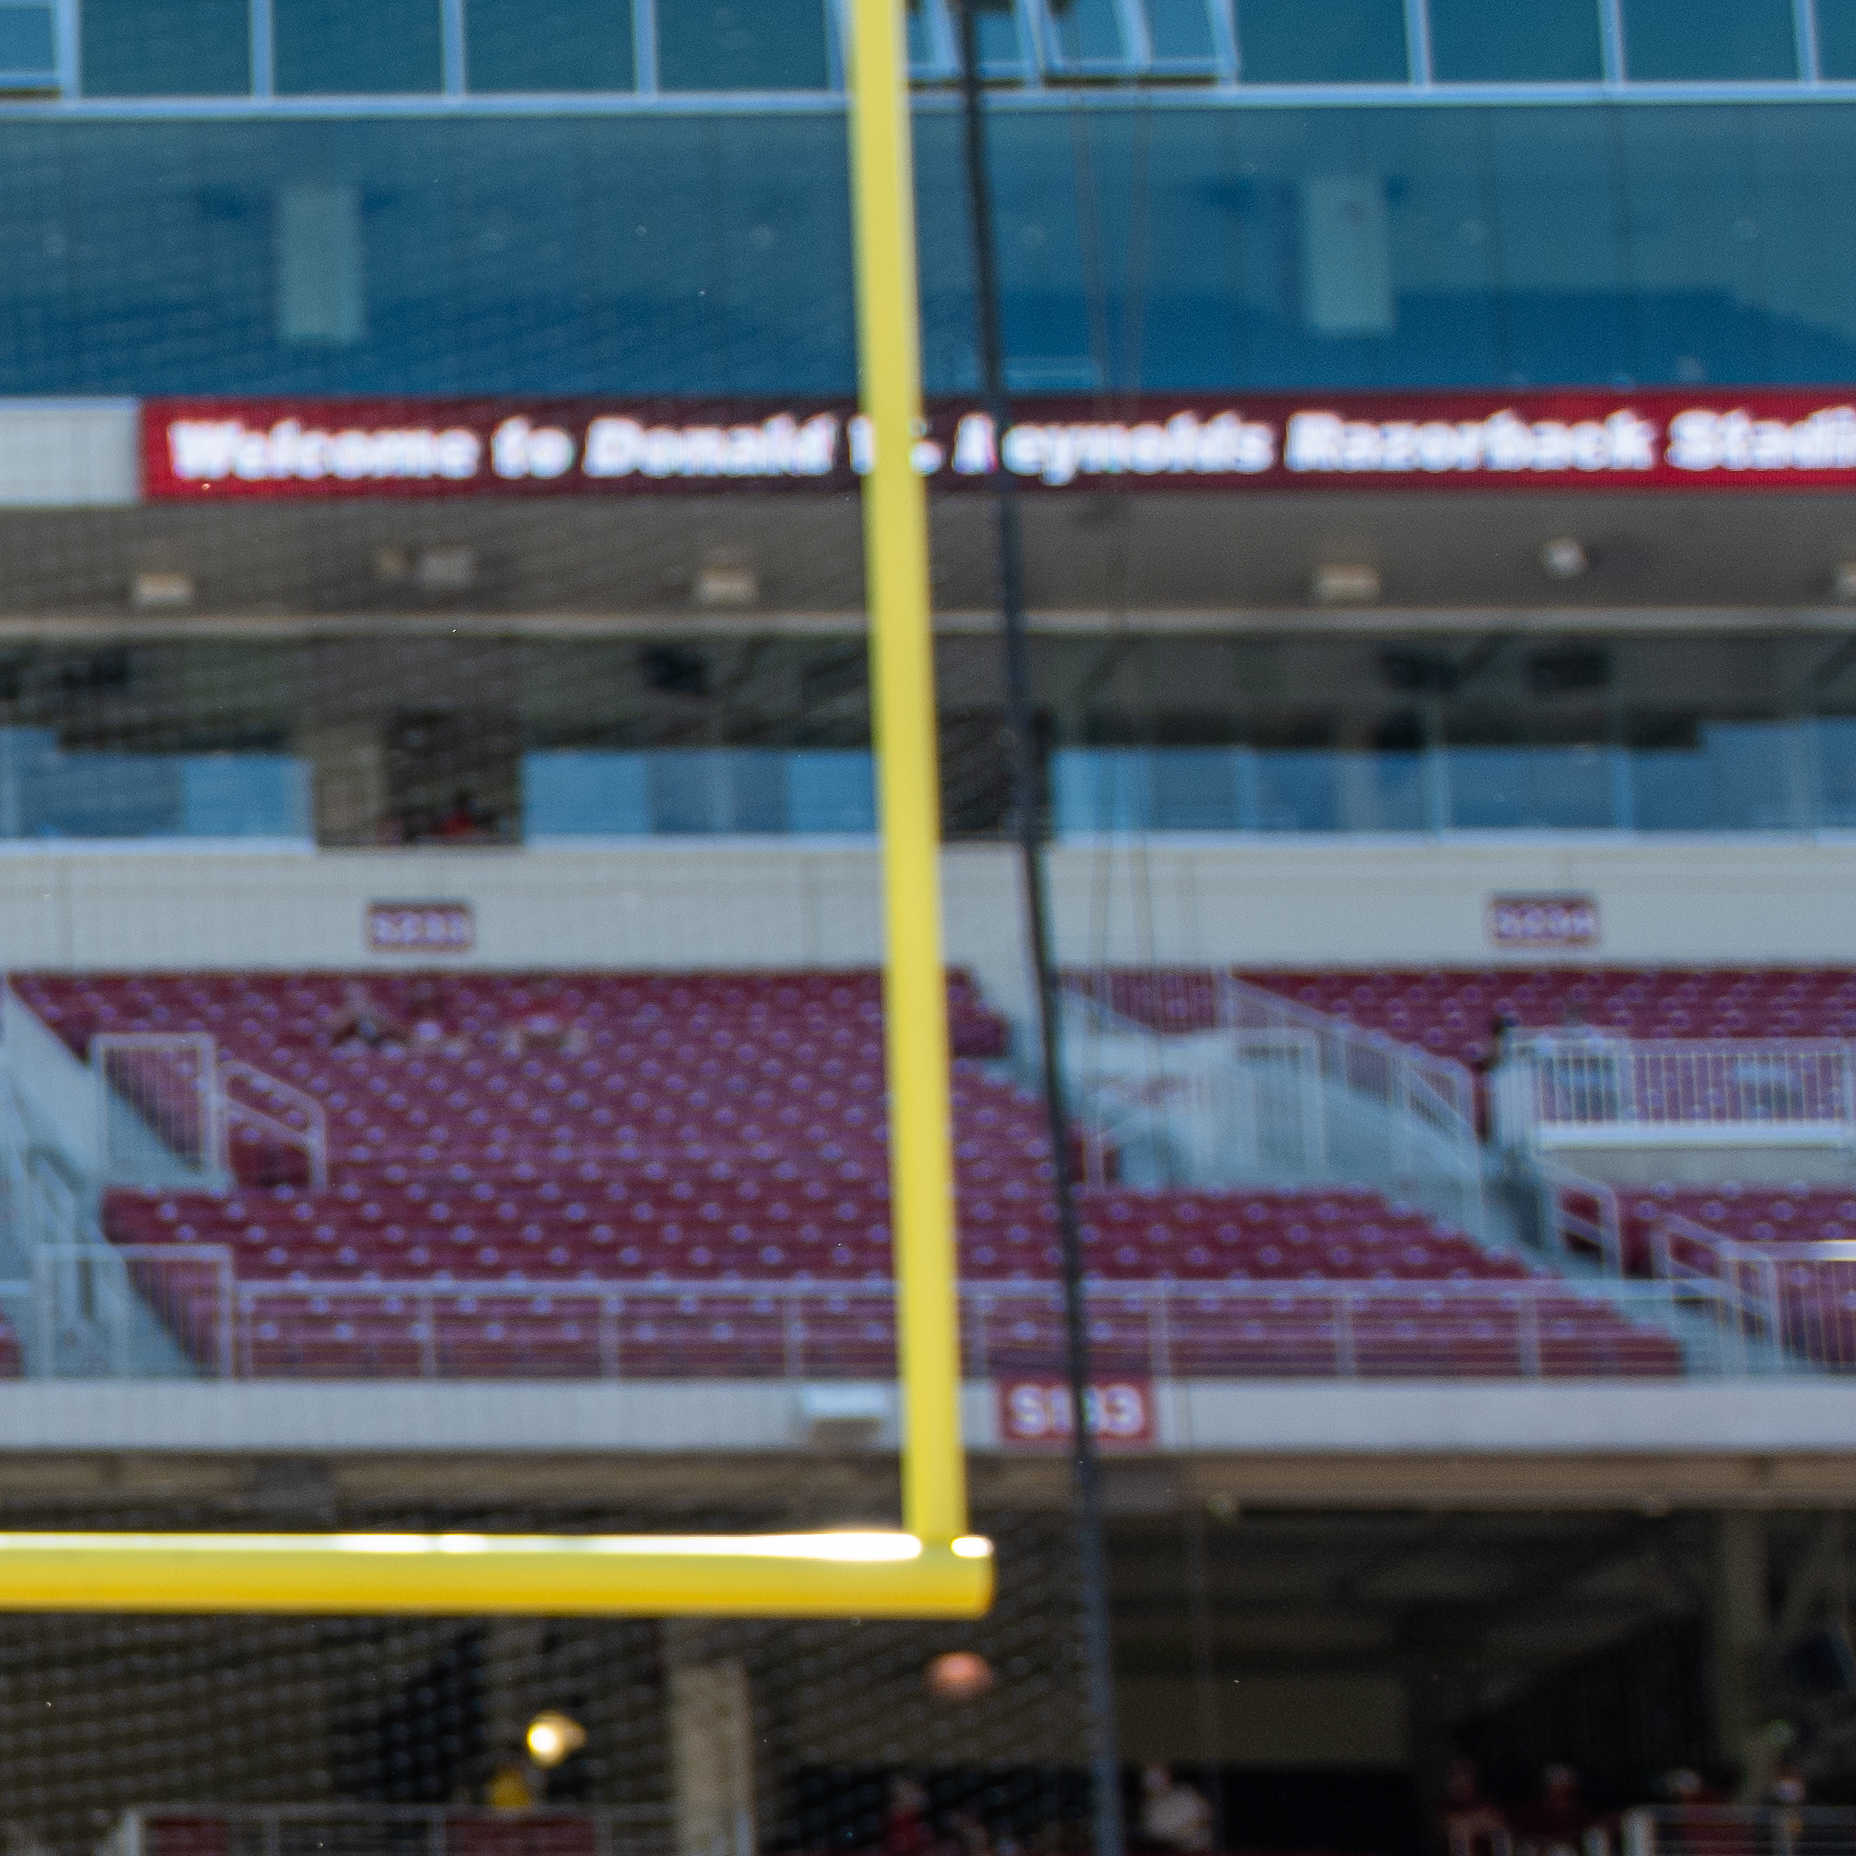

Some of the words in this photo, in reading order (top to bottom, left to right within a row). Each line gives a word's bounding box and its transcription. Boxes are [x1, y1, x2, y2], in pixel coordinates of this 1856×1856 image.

[167, 419, 481, 480] Welcome
[490, 415, 575, 479] to
[583, 411, 836, 477] Donald
[1286, 406, 1656, 473] Razorback
